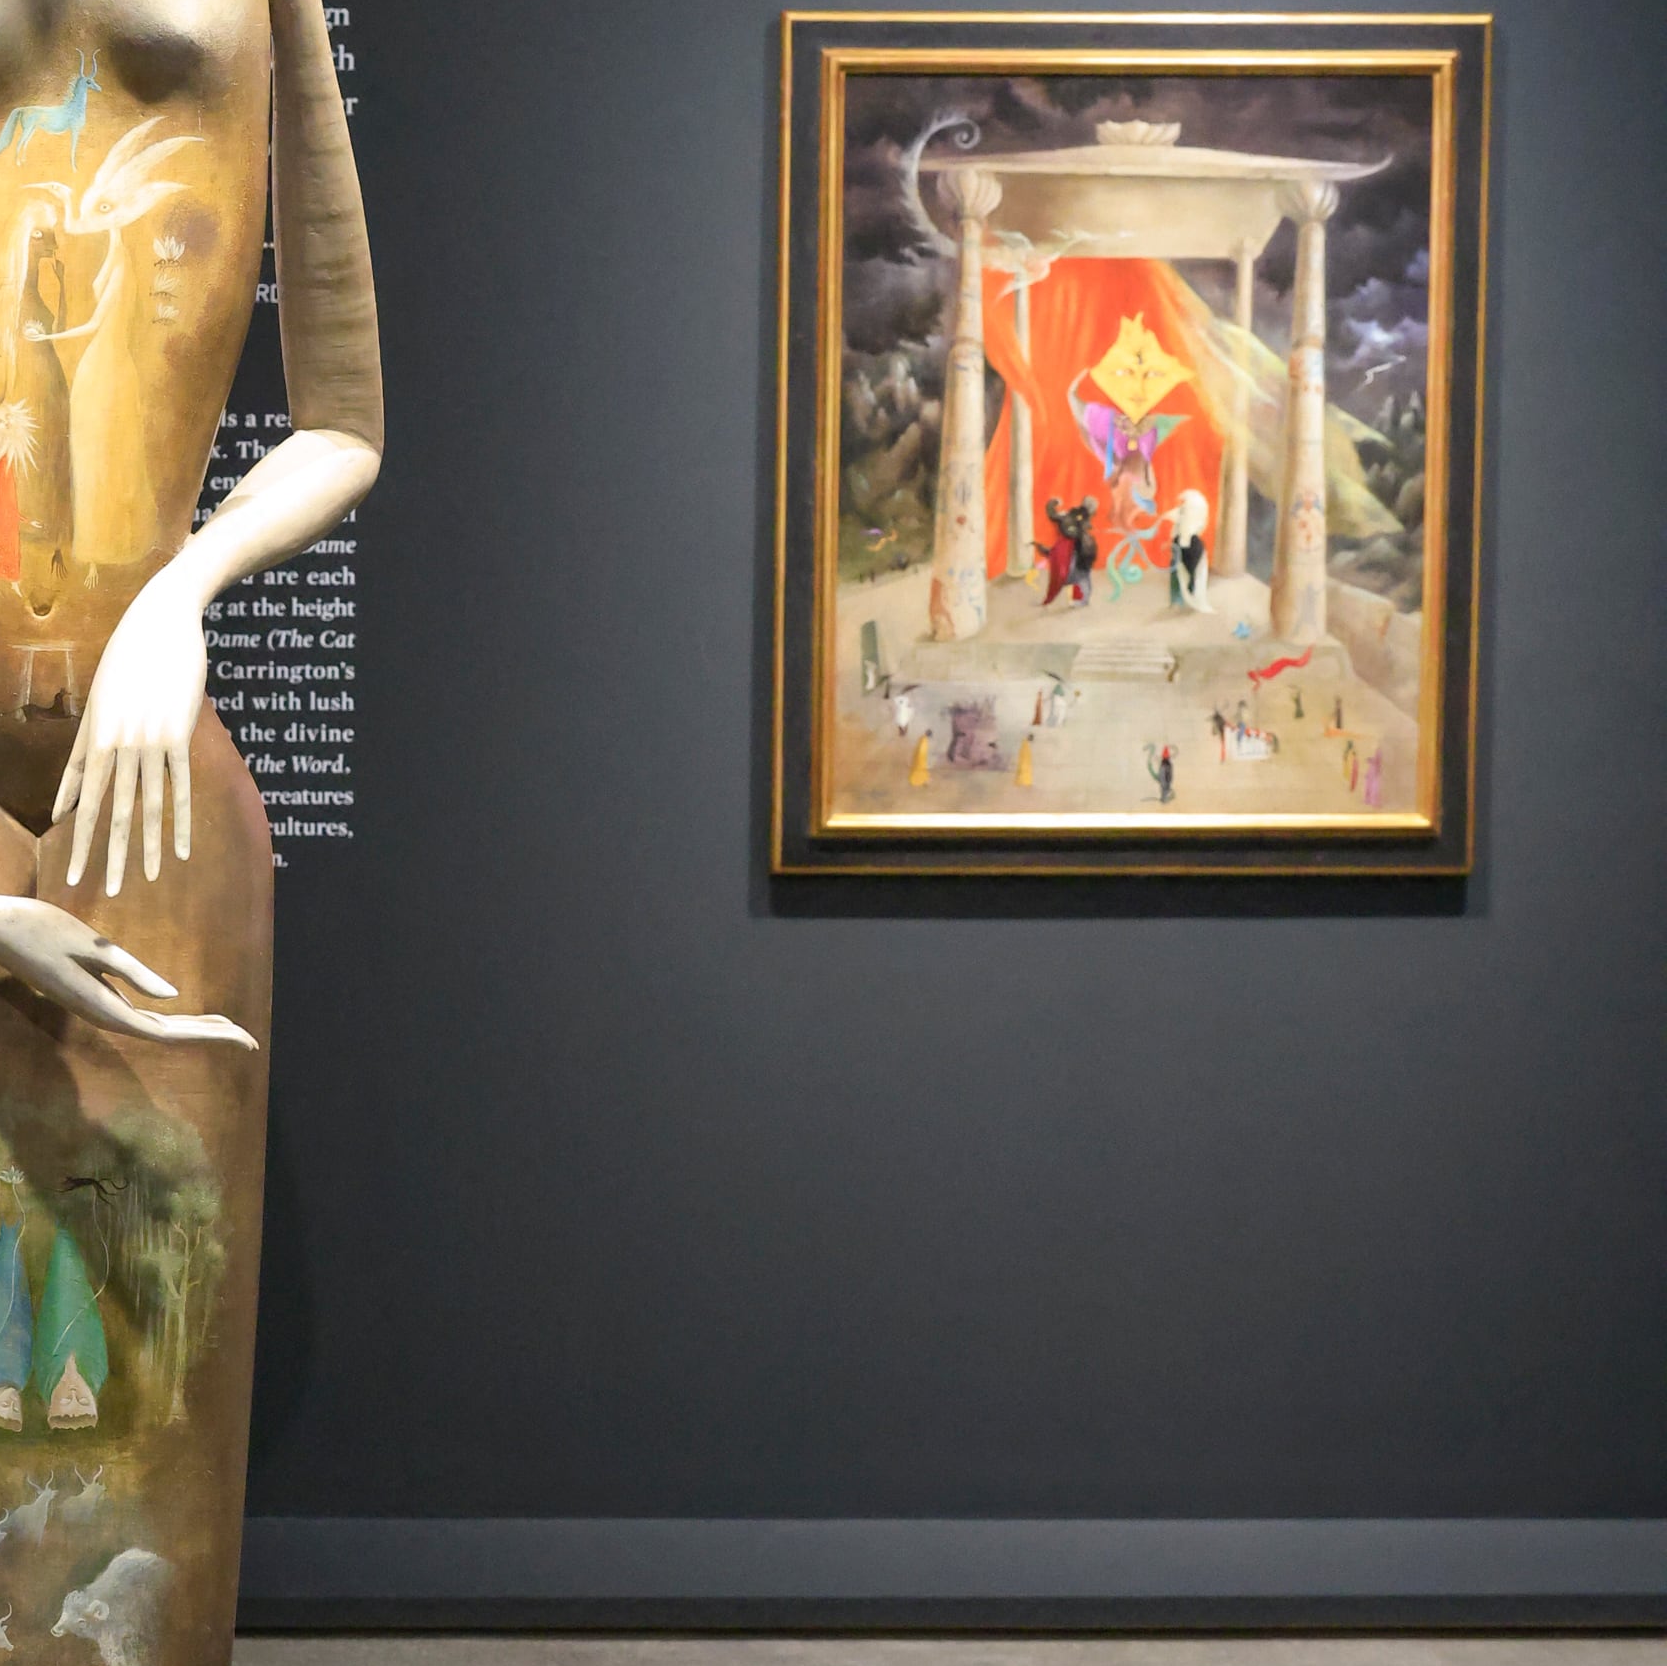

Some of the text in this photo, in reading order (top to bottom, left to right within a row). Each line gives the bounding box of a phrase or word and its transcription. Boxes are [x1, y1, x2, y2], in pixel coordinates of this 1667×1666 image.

[244, 412, 257, 428] a
[263, 570, 300, 585] are
[306, 565, 357, 585] each
[226, 601, 248, 617] at
[252, 596, 286, 617] the
[291, 596, 357, 622] height
[204, 630, 262, 649] Dame
[266, 628, 315, 652] (The
[319, 630, 357, 649] Cat
[216, 660, 356, 684] Carrington's
[252, 690, 302, 711] with
[309, 690, 355, 711] lush
[240, 722, 277, 743] the
[283, 721, 355, 743] divine
[255, 753, 287, 774] the
[260, 788, 354, 805] creatures
